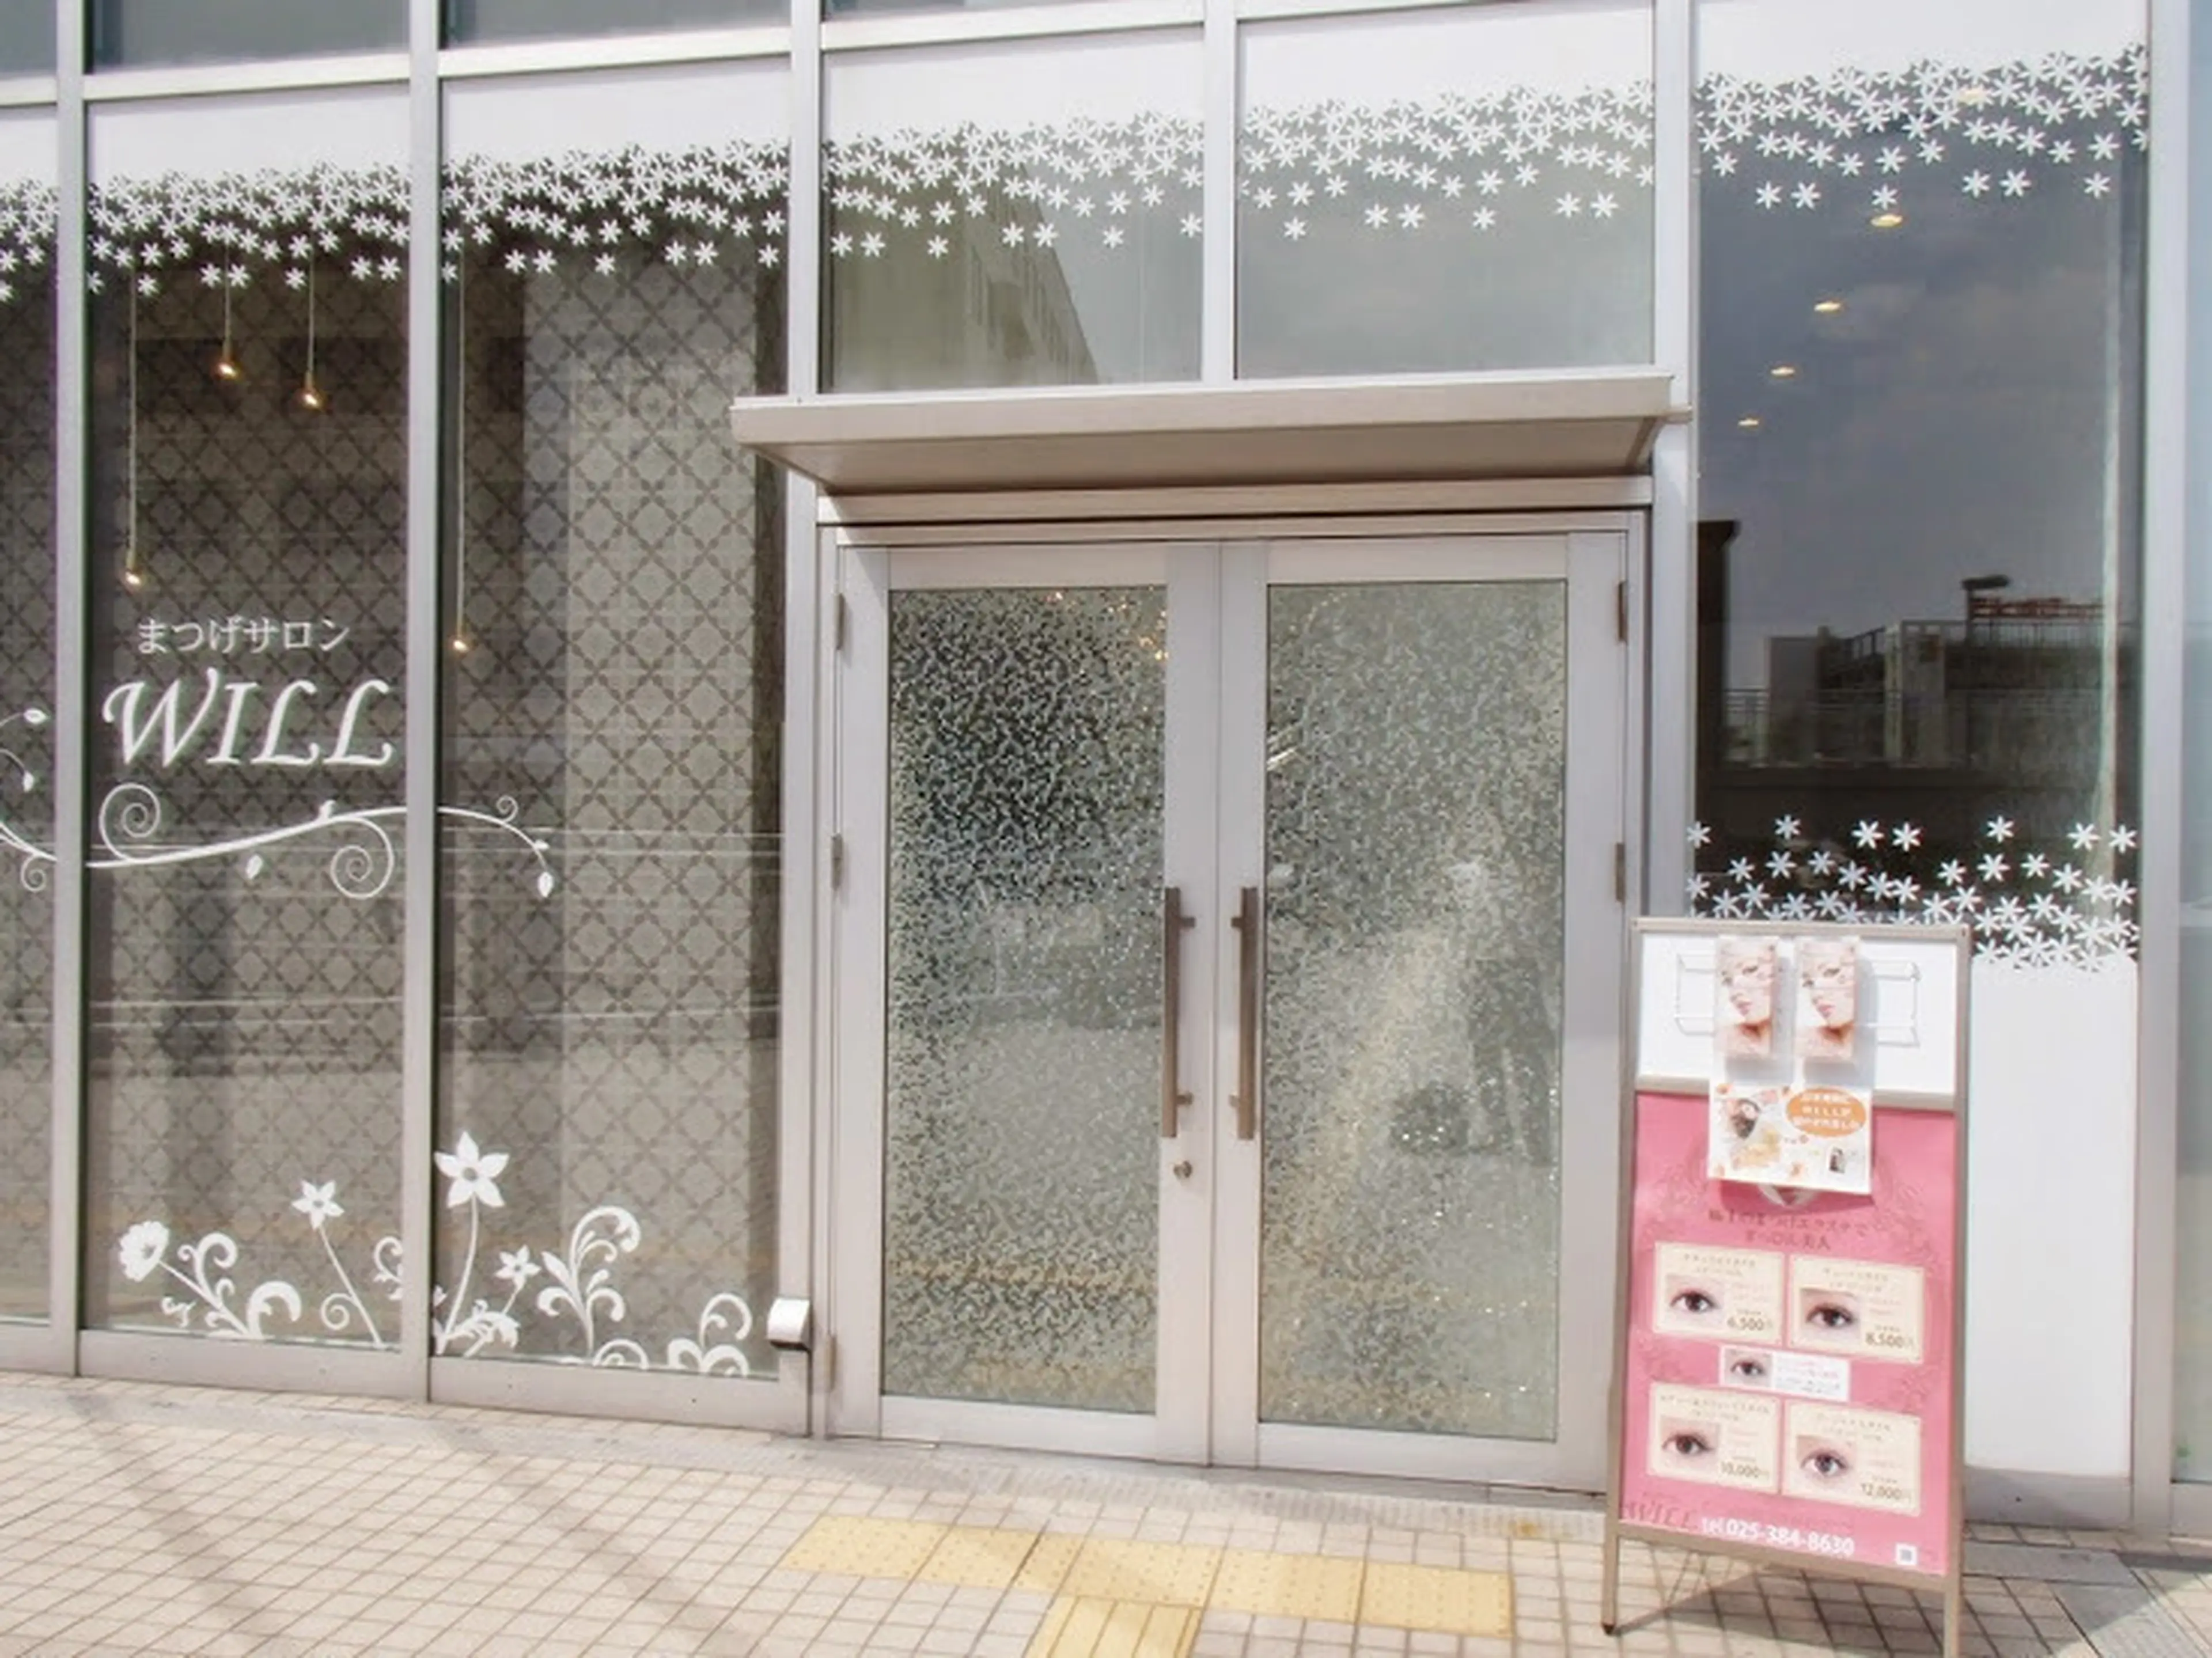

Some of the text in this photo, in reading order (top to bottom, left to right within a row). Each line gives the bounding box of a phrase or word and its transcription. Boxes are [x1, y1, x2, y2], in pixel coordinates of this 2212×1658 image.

[137, 616, 349, 654] まつげサロン
[102, 666, 394, 768] WILL
